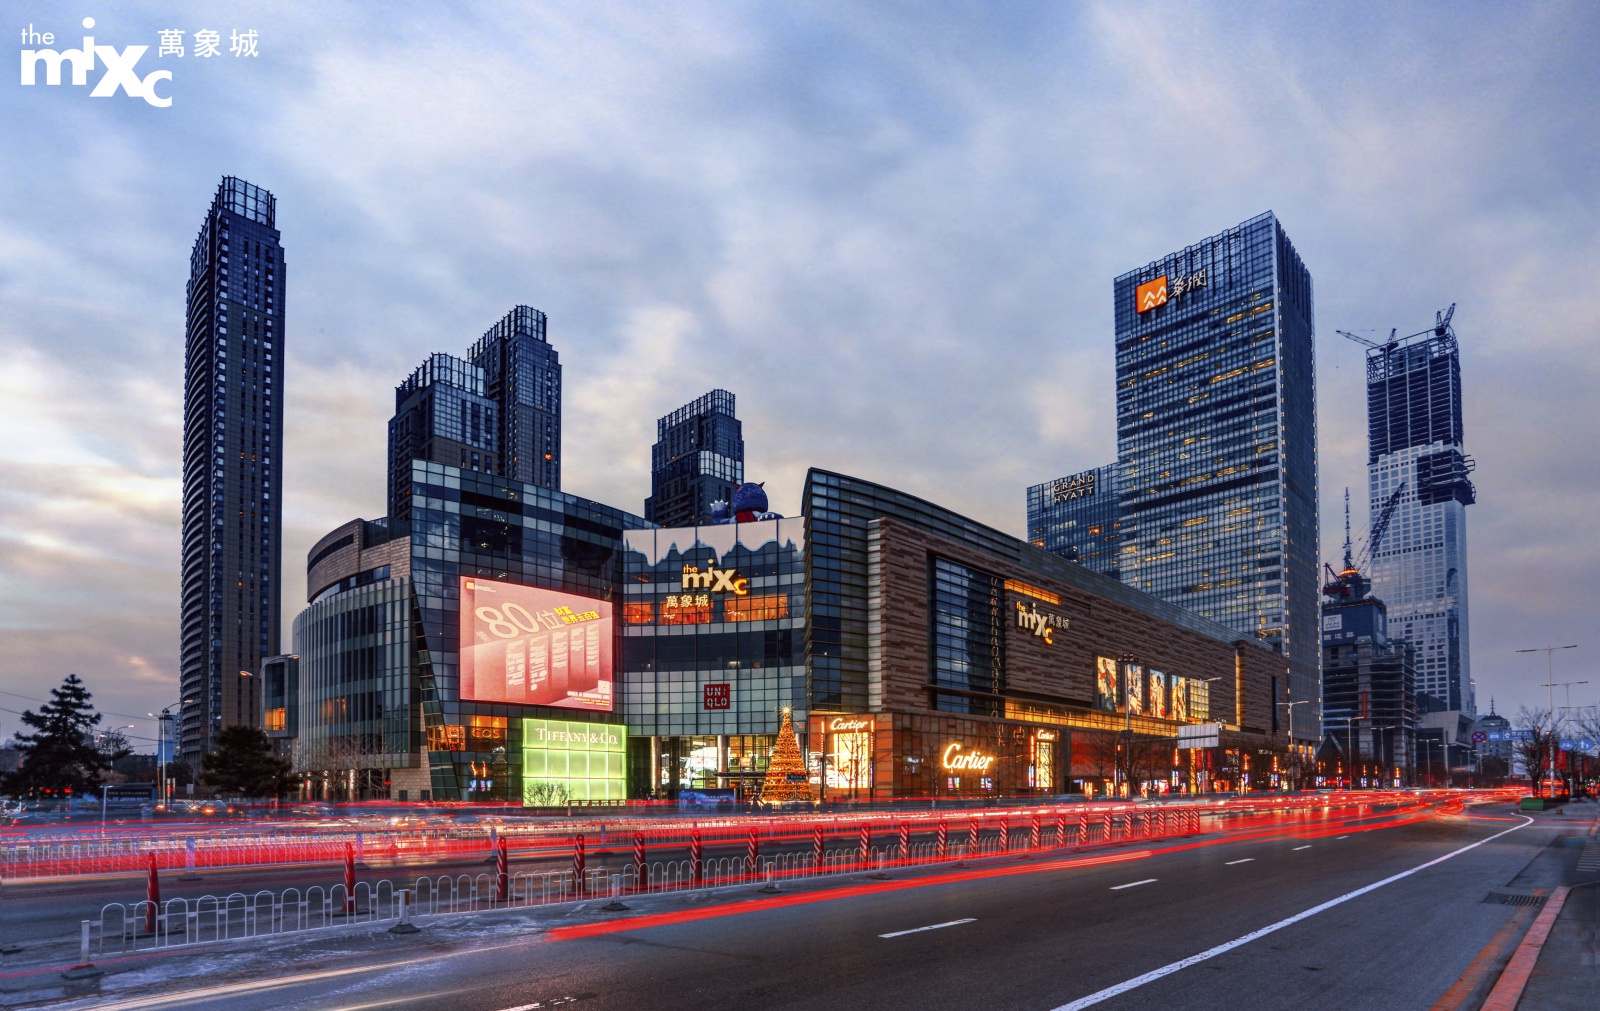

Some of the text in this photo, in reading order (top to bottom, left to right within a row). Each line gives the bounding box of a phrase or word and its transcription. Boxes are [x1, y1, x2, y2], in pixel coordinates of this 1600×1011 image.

[1053, 474, 1095, 492] GRAND
[1054, 486, 1094, 504] HYATT
[683, 563, 698, 573] the
[665, 594, 709, 609] 萬象城
[830, 718, 868, 731] Cartier
[471, 728, 501, 739] COS
[1037, 729, 1055, 740] Cartier
[943, 743, 994, 770] Cartier
